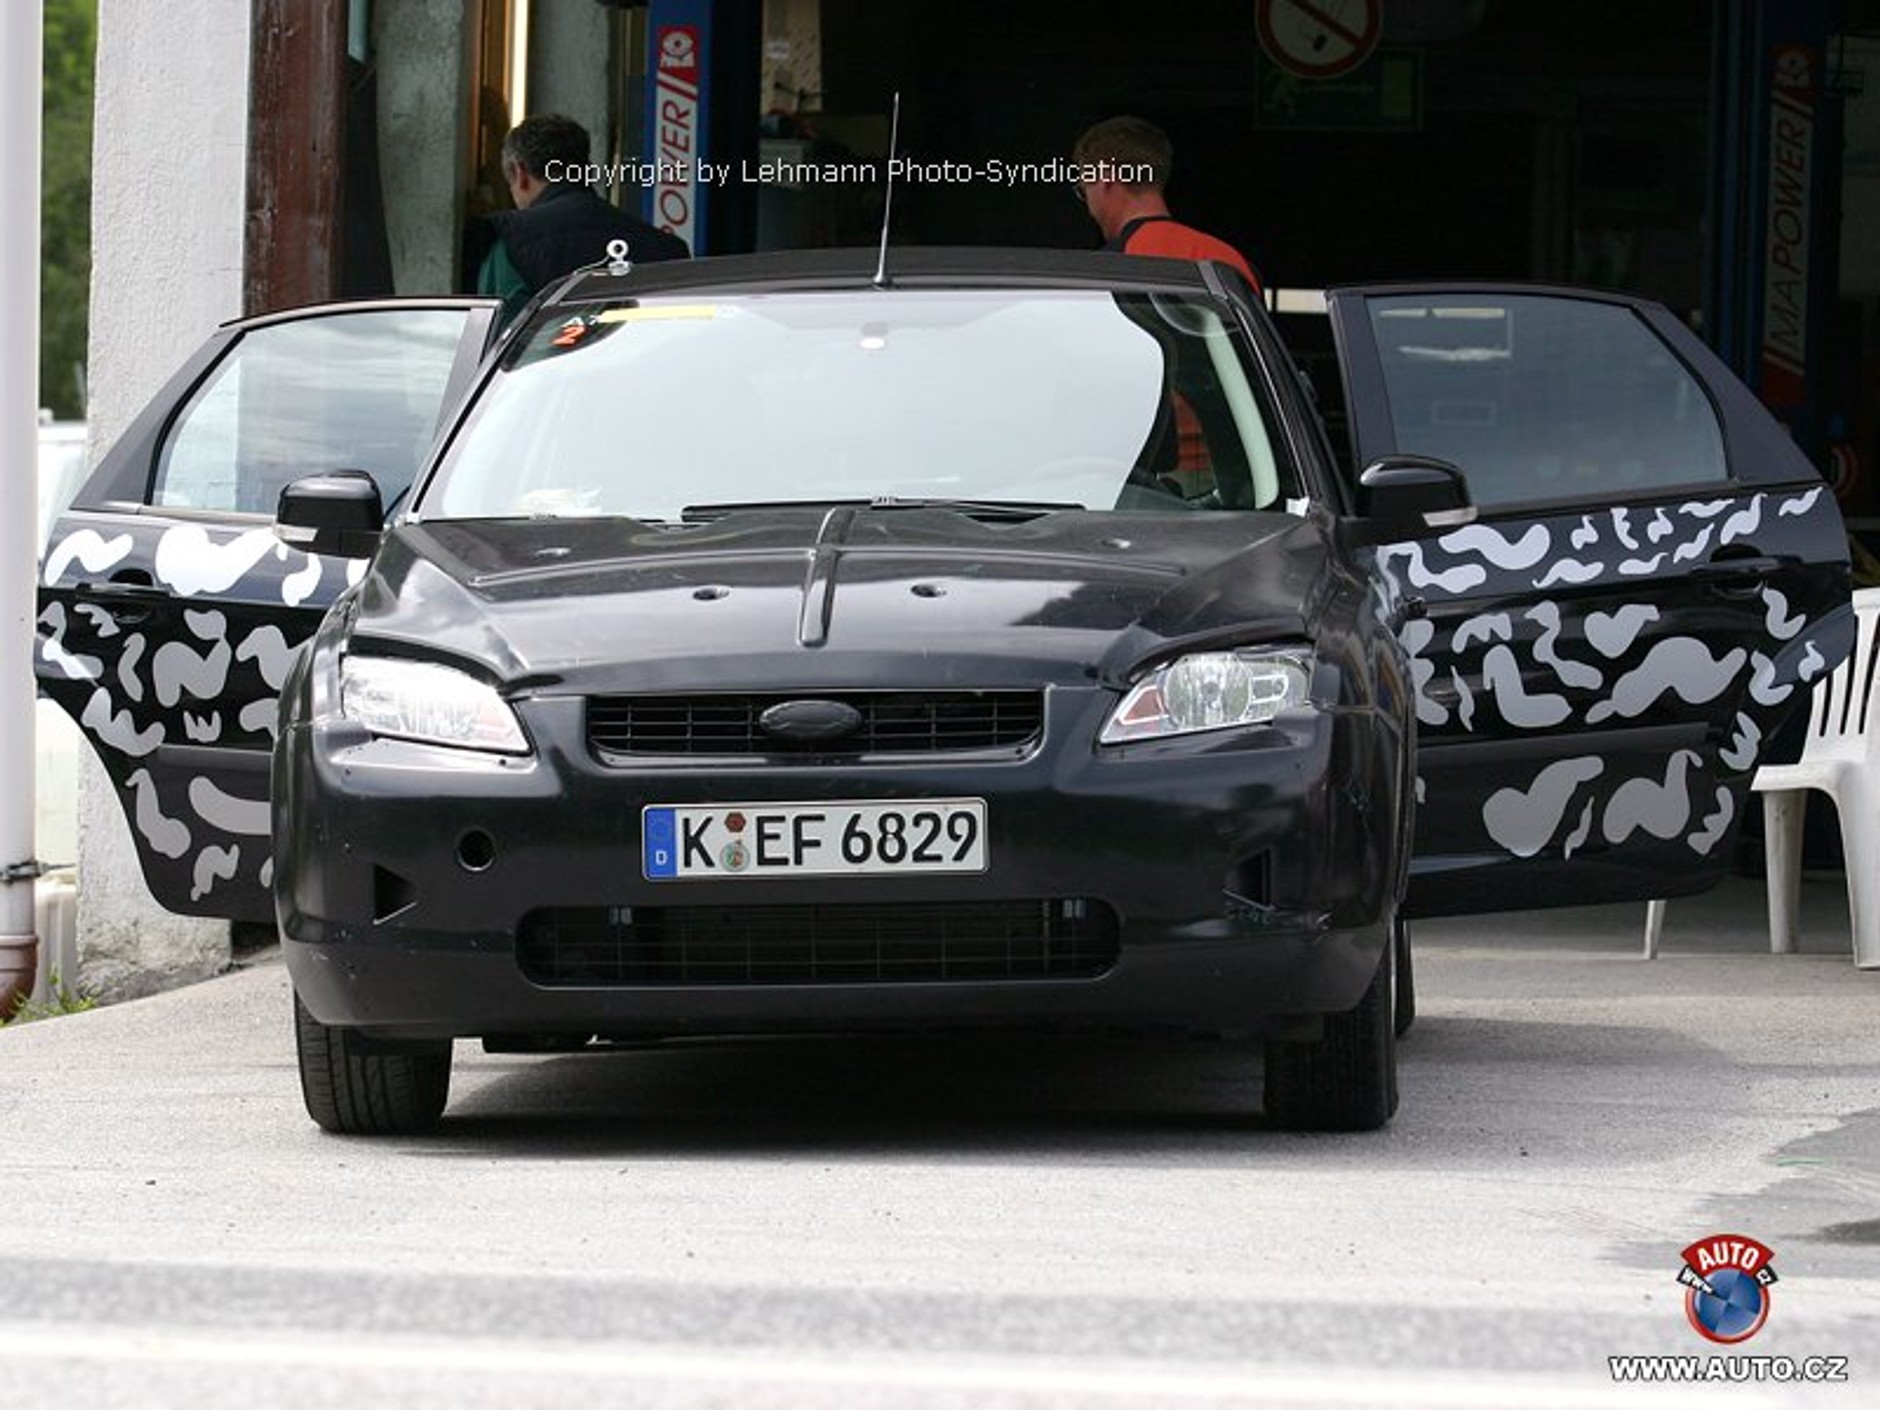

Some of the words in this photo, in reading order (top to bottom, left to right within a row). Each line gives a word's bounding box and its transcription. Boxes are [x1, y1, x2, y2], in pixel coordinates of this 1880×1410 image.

[682, 816, 716, 868] K
[756, 813, 826, 867] EF
[841, 810, 978, 864] 6829
